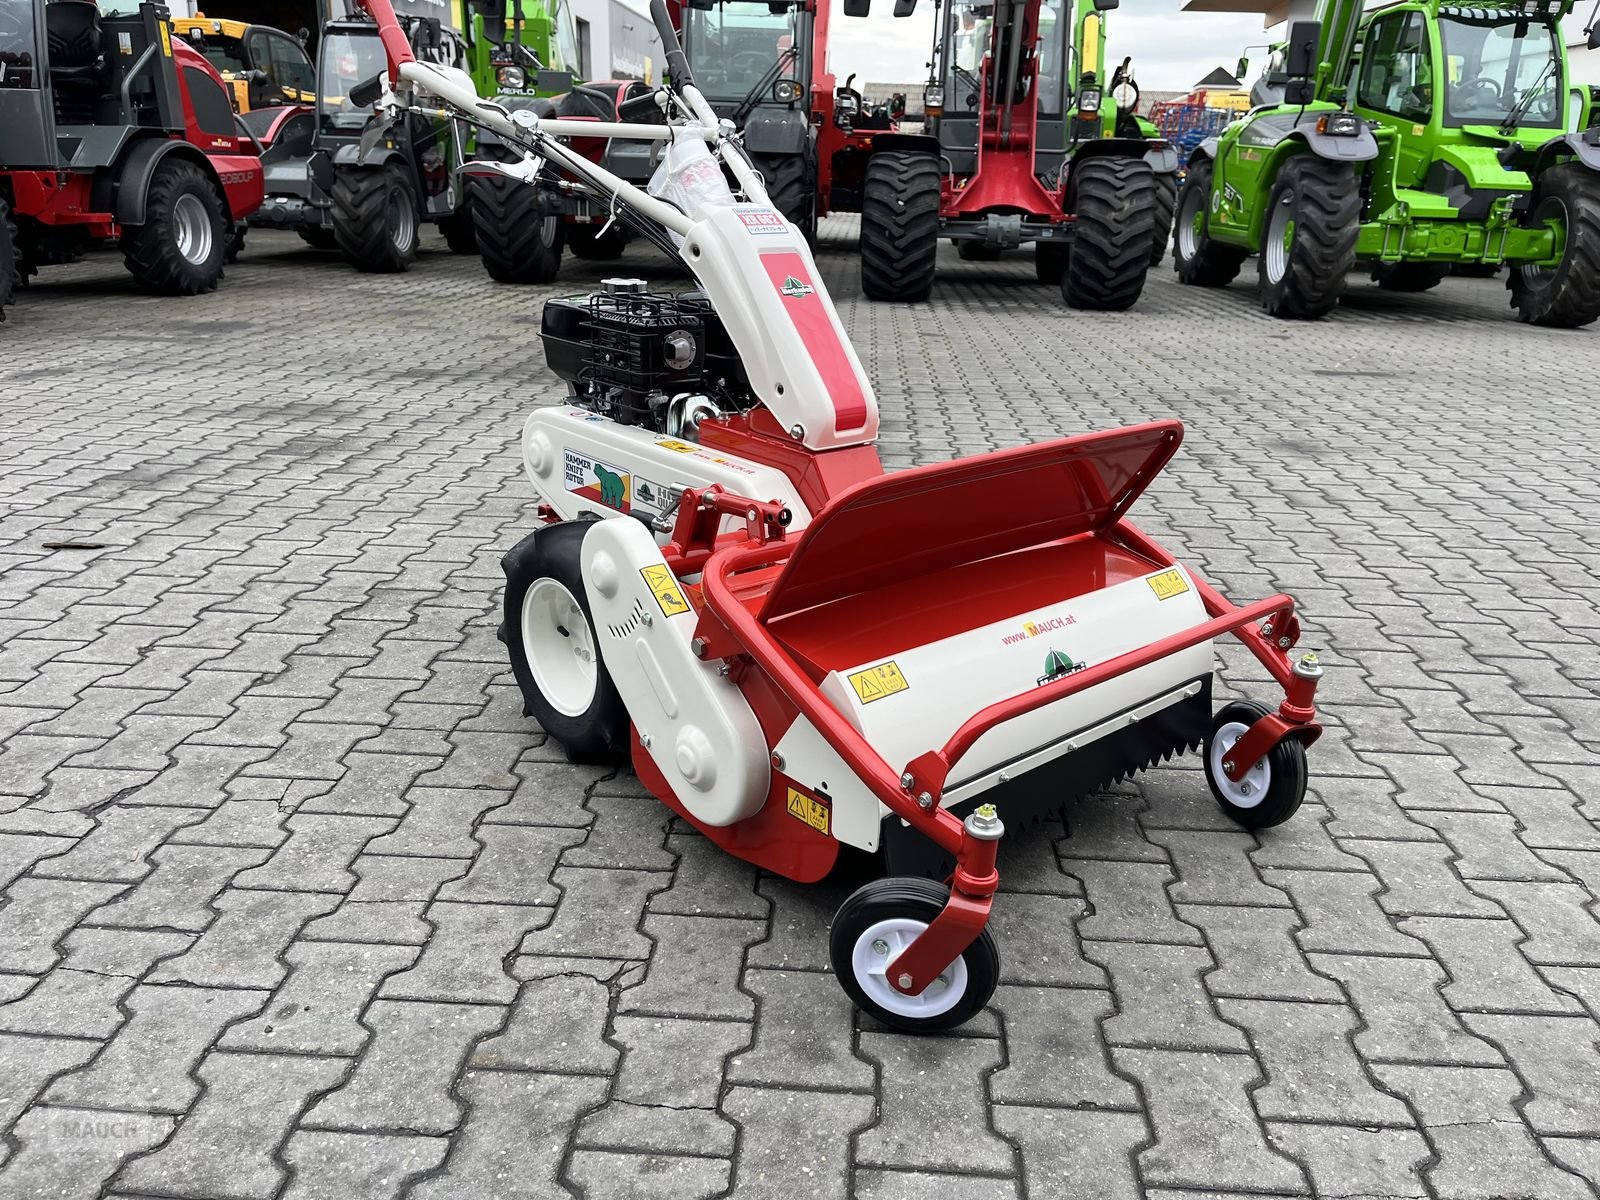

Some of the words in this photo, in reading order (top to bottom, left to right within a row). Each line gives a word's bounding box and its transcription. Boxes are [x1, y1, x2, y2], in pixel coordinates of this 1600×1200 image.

[496, 86, 536, 96] MERLO
[565, 452, 592, 470] HAMMER
[565, 462, 584, 477] KNIFE
[565, 471, 585, 487] ROTOR
[1001, 613, 1077, 646] www.MAUCH.at
